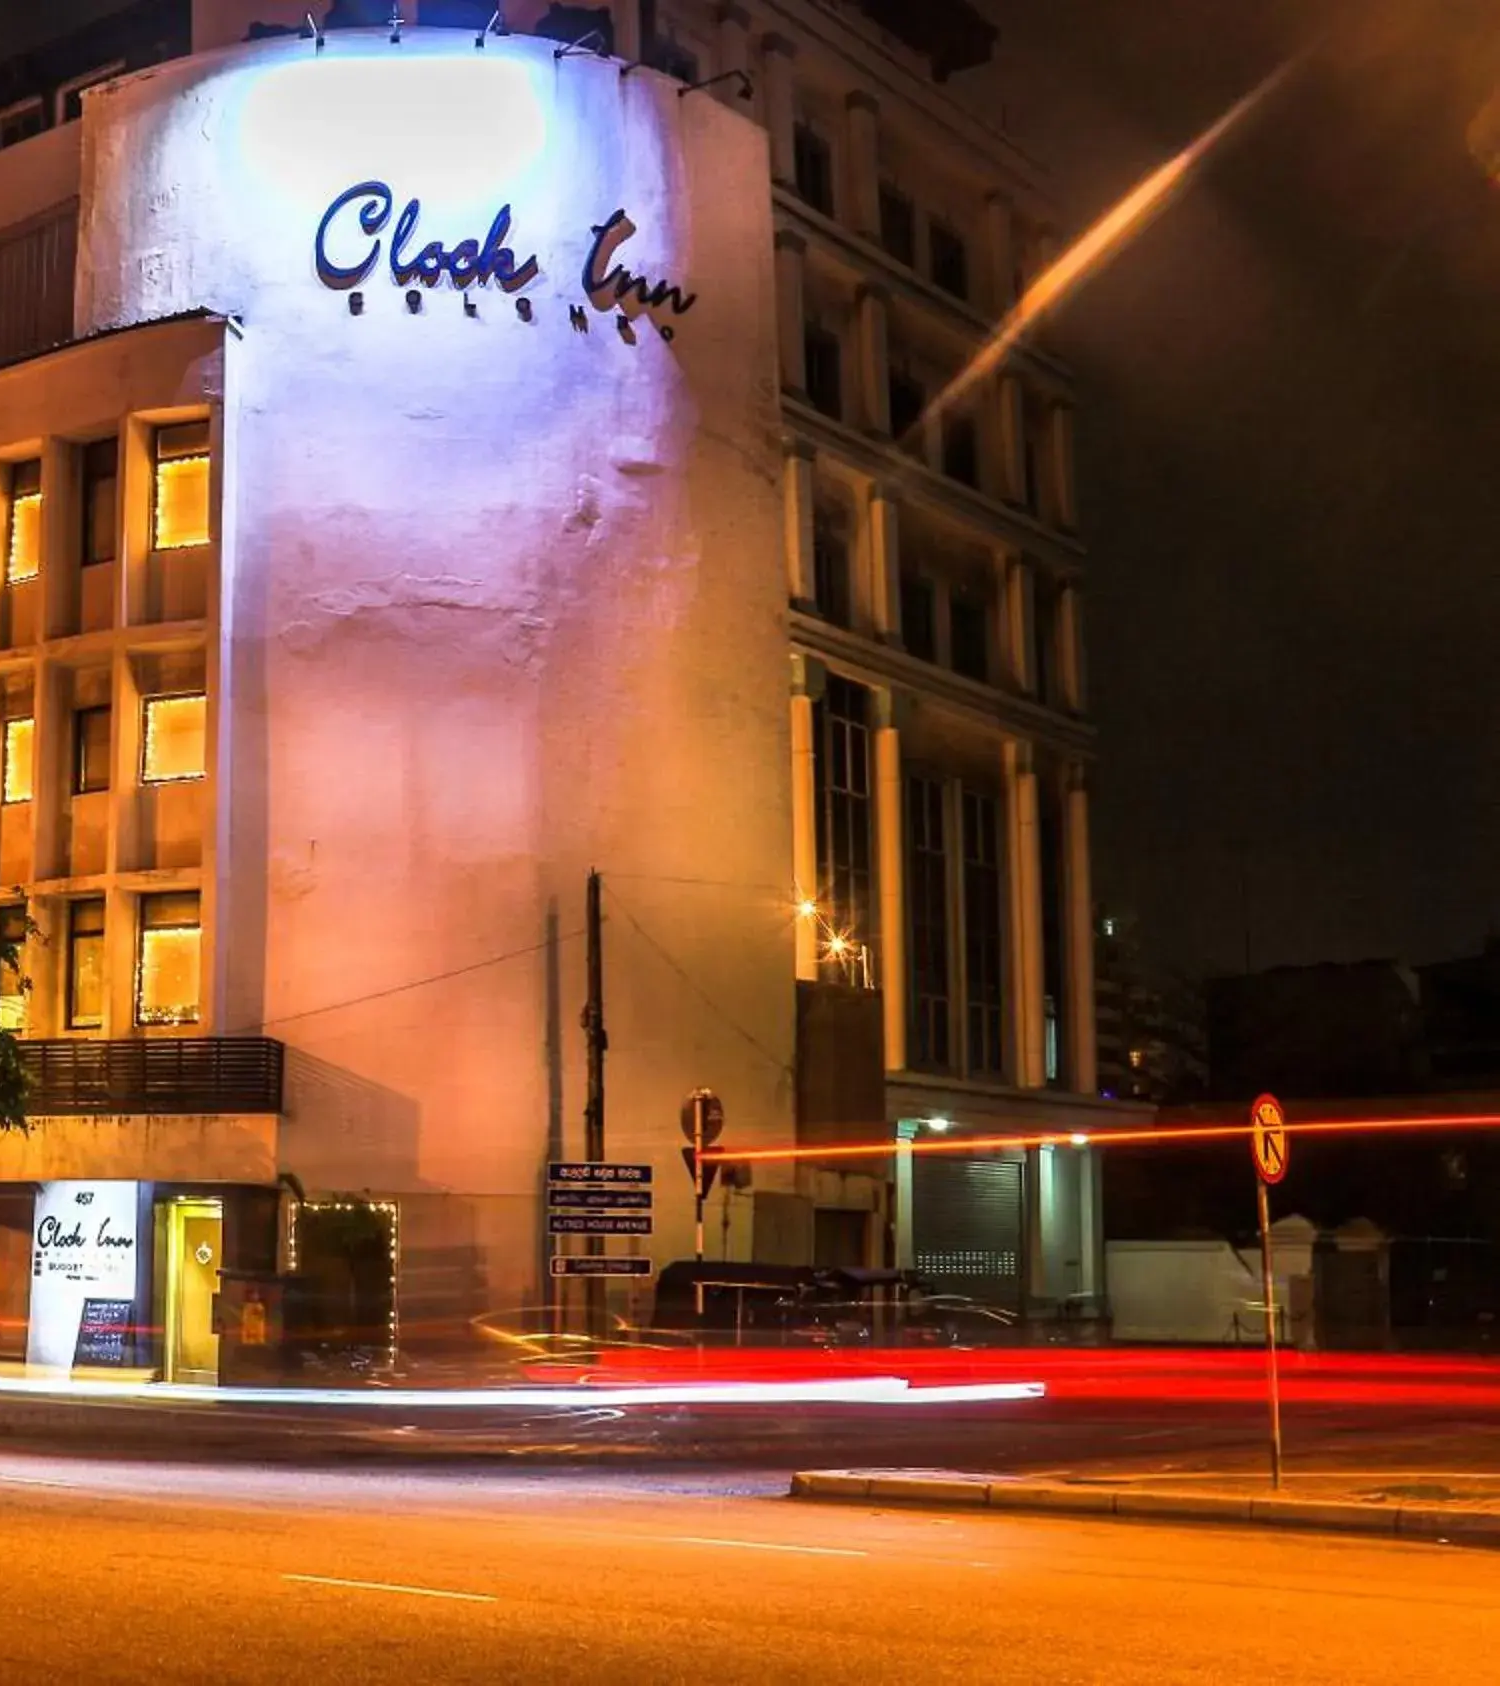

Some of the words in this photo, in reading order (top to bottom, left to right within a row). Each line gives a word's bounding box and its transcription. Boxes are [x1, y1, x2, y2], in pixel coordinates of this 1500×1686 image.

[315, 180, 539, 291] Clock
[581, 208, 697, 312] Inn
[75, 1192, 94, 1205] 457
[37, 1216, 87, 1248] Clock
[97, 1217, 134, 1248] Inn
